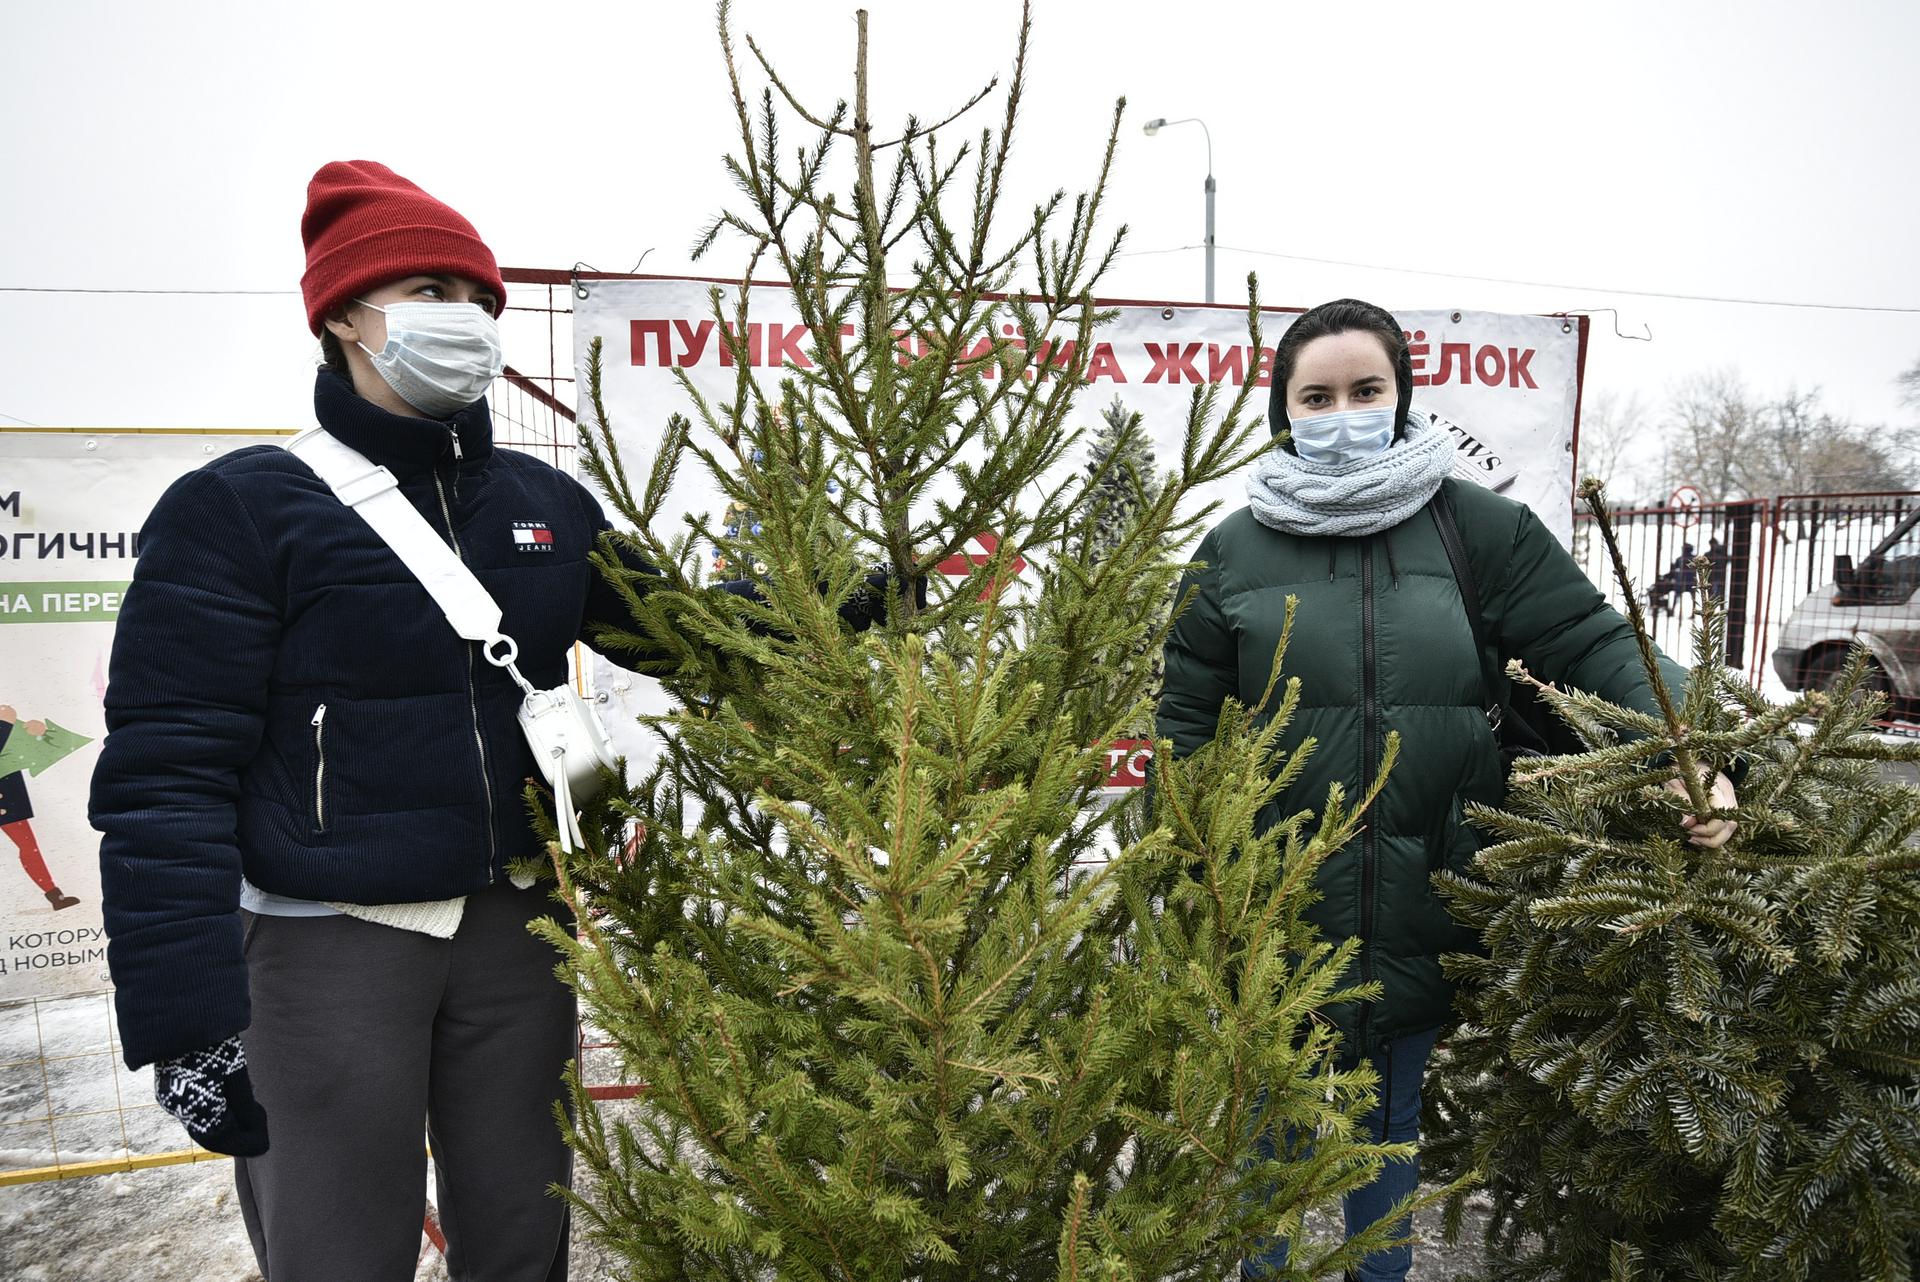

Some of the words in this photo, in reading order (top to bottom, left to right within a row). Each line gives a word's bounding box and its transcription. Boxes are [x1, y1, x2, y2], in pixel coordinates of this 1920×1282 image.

[1142, 342, 1276, 387] ЖИВ
[1401, 329, 1540, 389] ЁЛОК
[0, 532, 140, 560] ГИЧН
[42, 592, 127, 613] ПЕРЕ
[14, 947, 104, 971] НОВЫМ
